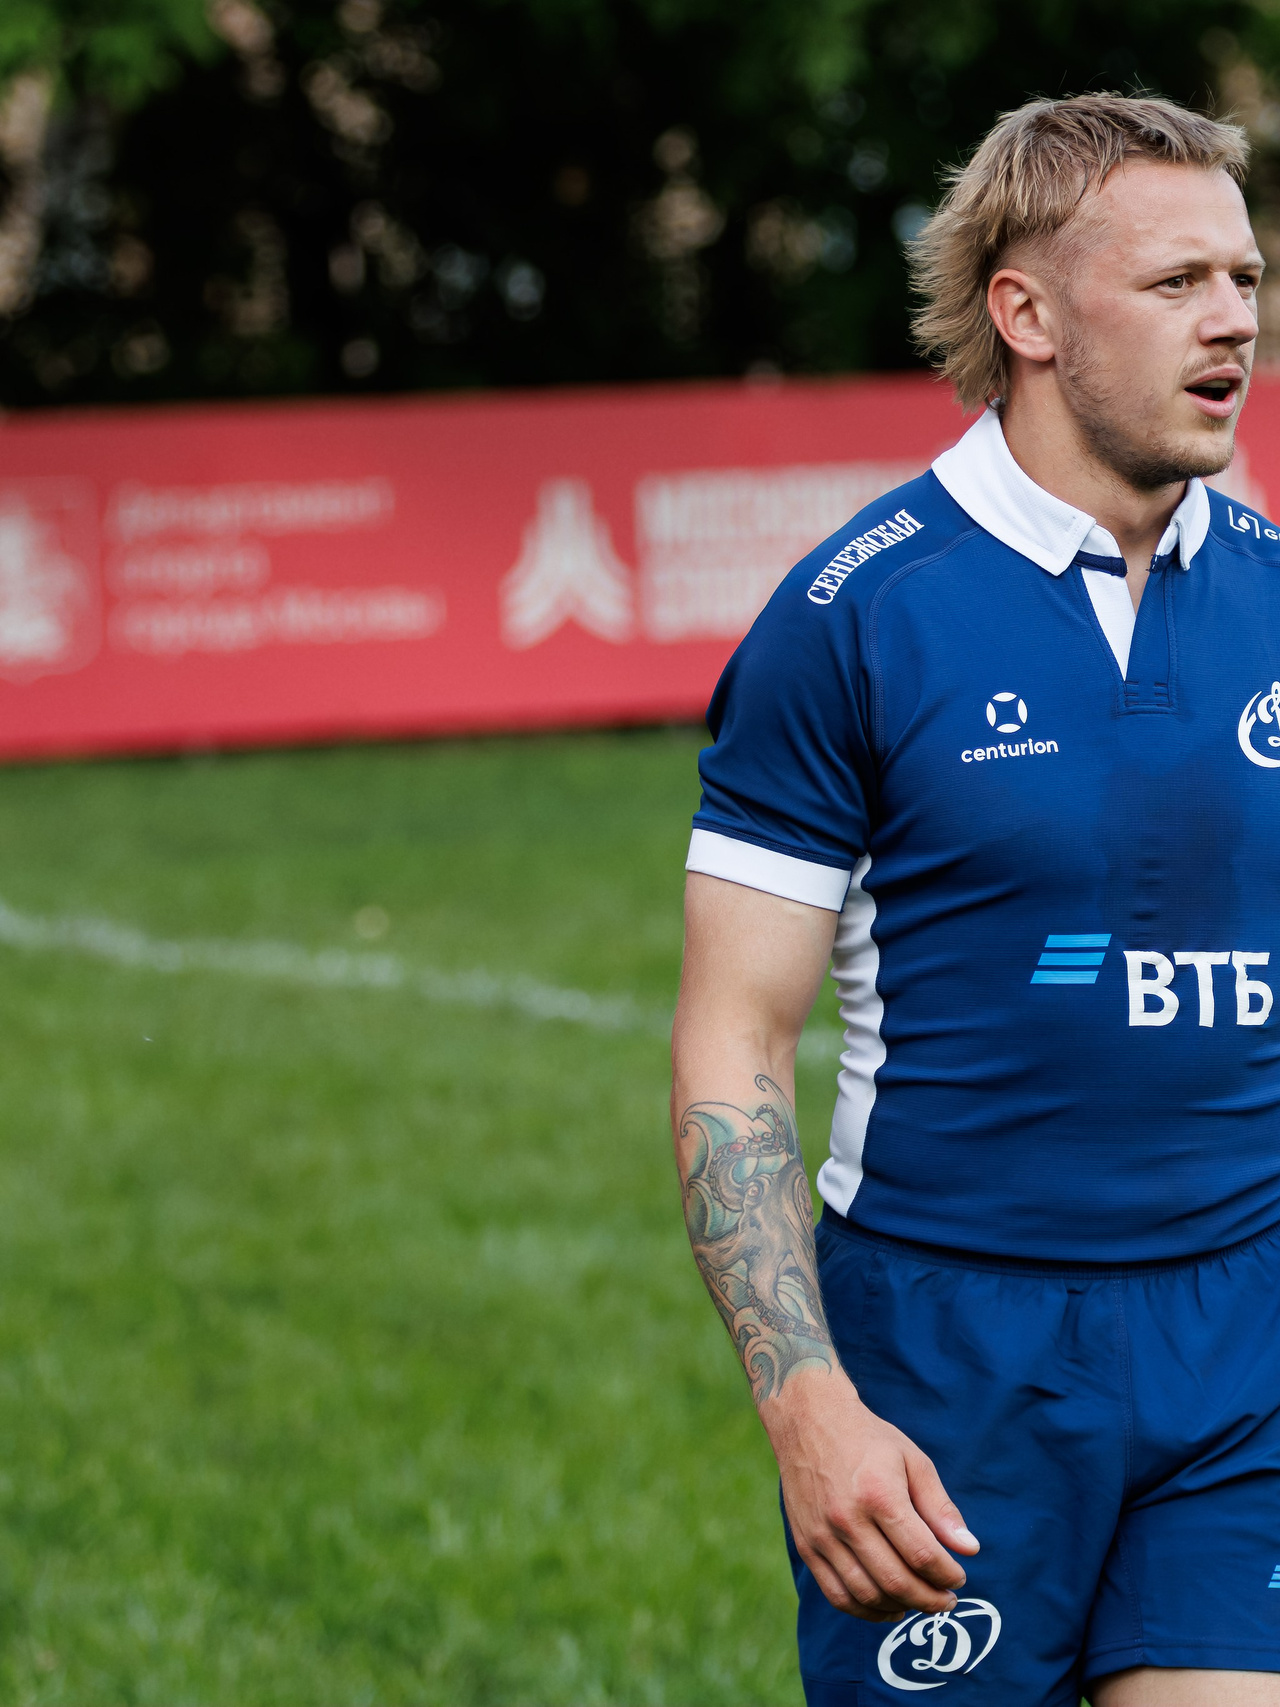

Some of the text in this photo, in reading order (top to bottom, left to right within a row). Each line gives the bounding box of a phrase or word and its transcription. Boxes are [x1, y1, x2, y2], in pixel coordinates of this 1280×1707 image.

[807, 509, 925, 605] СЕНЕЖСКАЯ
[961, 738, 1059, 763] centurion
[1122, 950, 1274, 1028] ВТБ
